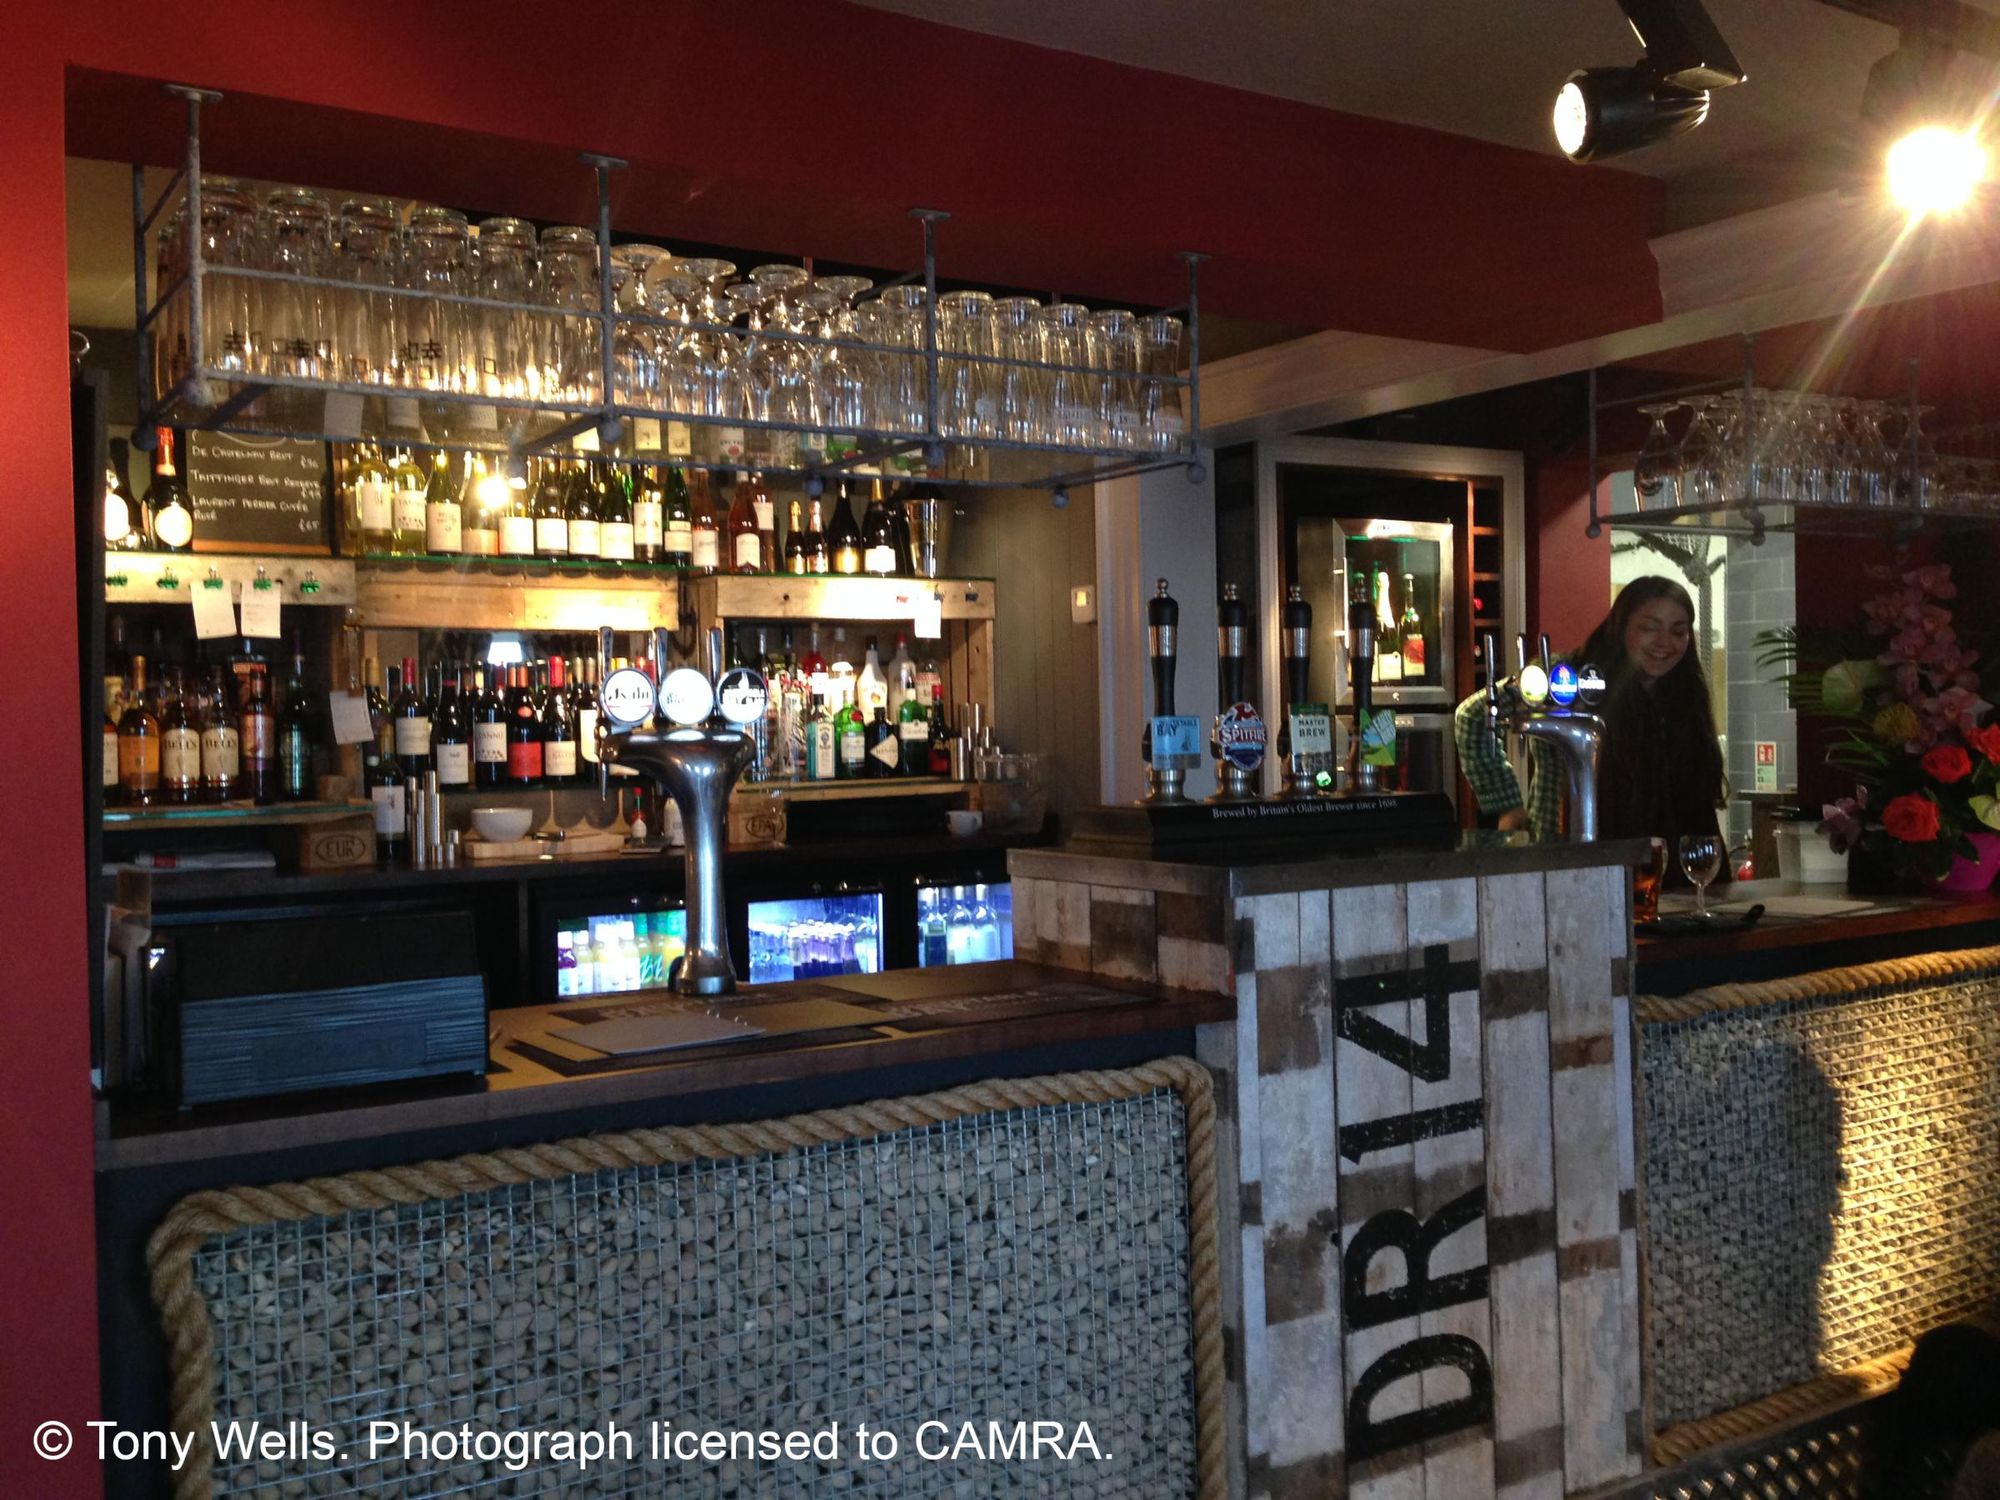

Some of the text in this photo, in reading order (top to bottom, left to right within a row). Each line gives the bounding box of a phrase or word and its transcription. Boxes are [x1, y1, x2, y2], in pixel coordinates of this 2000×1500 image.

[1298, 719, 1326, 727] MASTER
[1156, 724, 1178, 737] BAY
[1221, 727, 1266, 743] SPITFIRE
[1299, 727, 1326, 738] BREW
[1212, 807, 1246, 819] Brewed
[1247, 806, 1257, 819] by
[1259, 804, 1295, 817] Britain's
[1297, 802, 1323, 814] Oldest
[1325, 802, 1354, 812] Brewer
[1356, 801, 1376, 811] since
